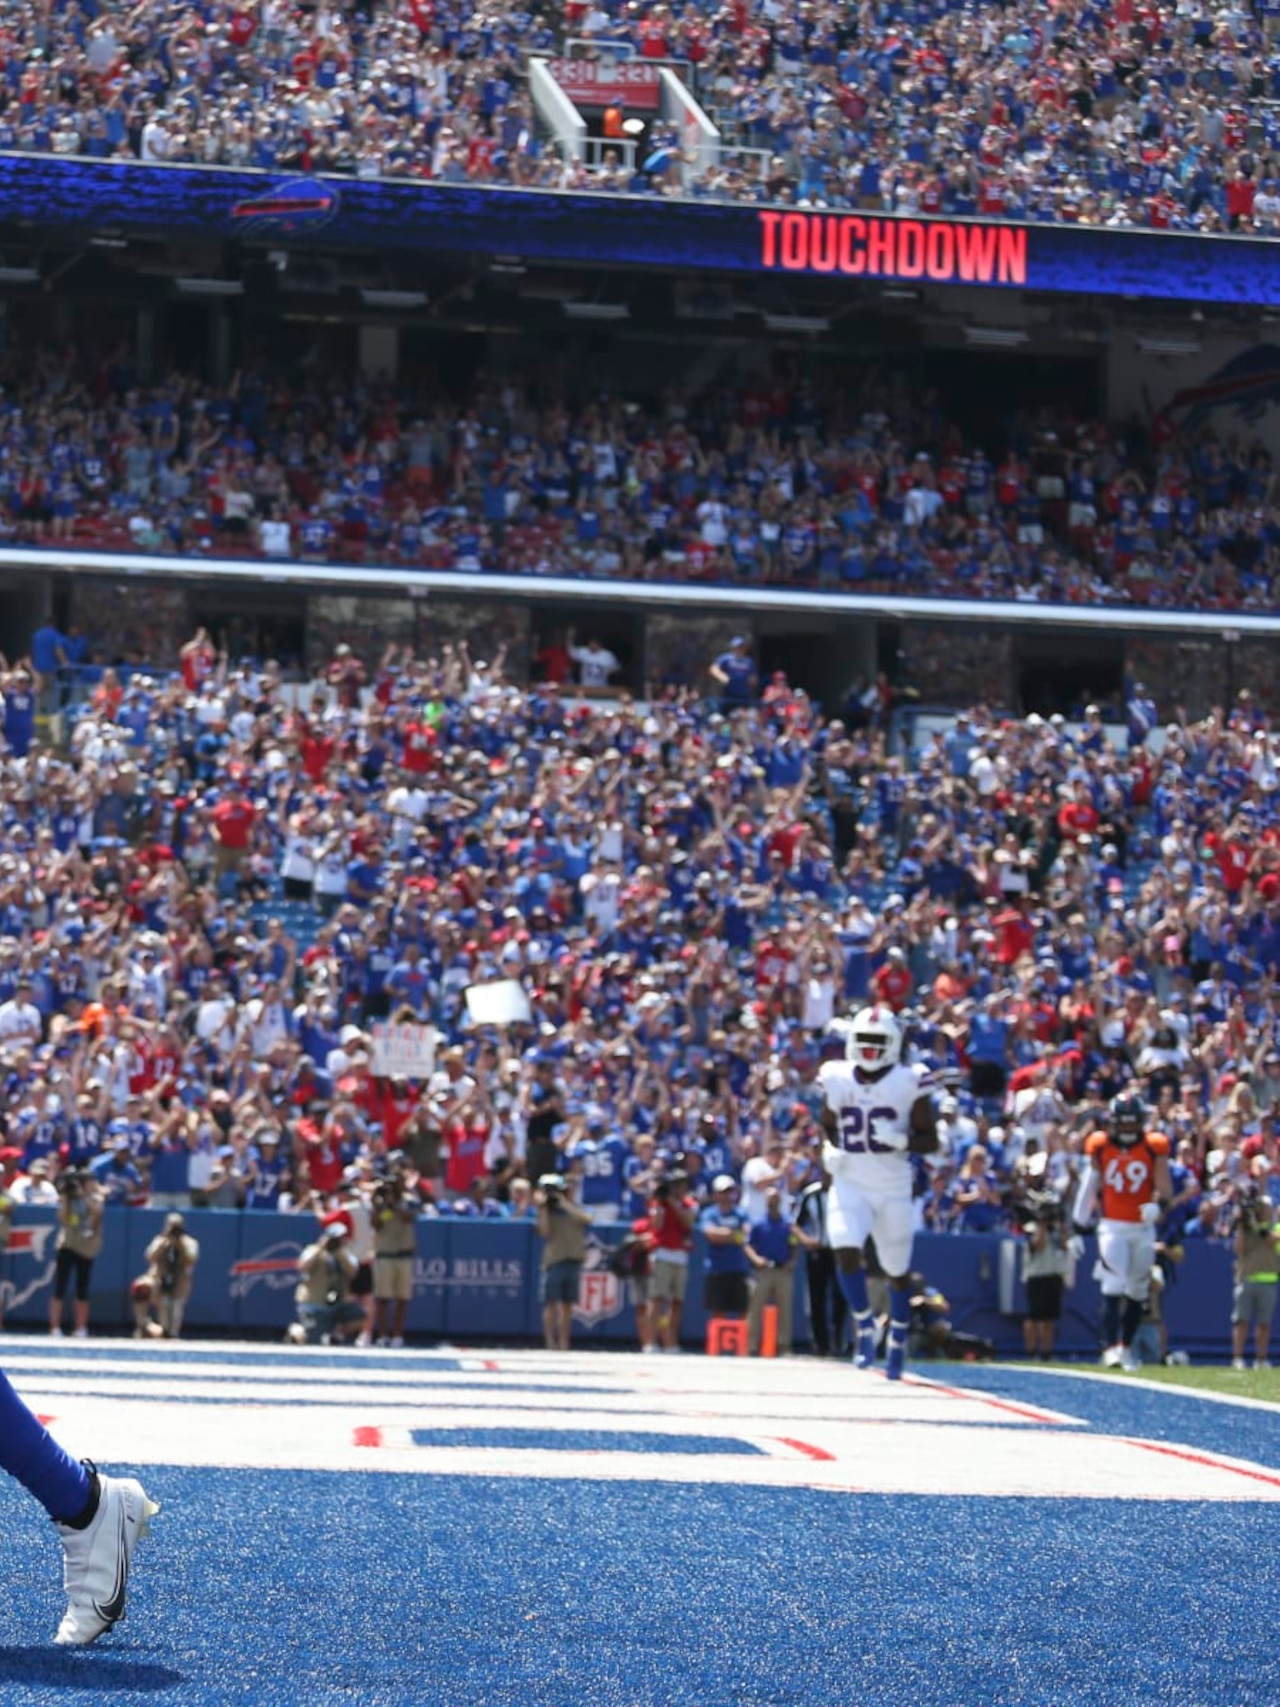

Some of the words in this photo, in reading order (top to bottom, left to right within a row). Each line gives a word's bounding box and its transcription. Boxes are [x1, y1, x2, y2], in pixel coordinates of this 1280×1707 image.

[759, 211, 1027, 284] TOUCHDOWN
[1106, 1160, 1148, 1194] 49
[455, 1259, 520, 1279] BILLS
